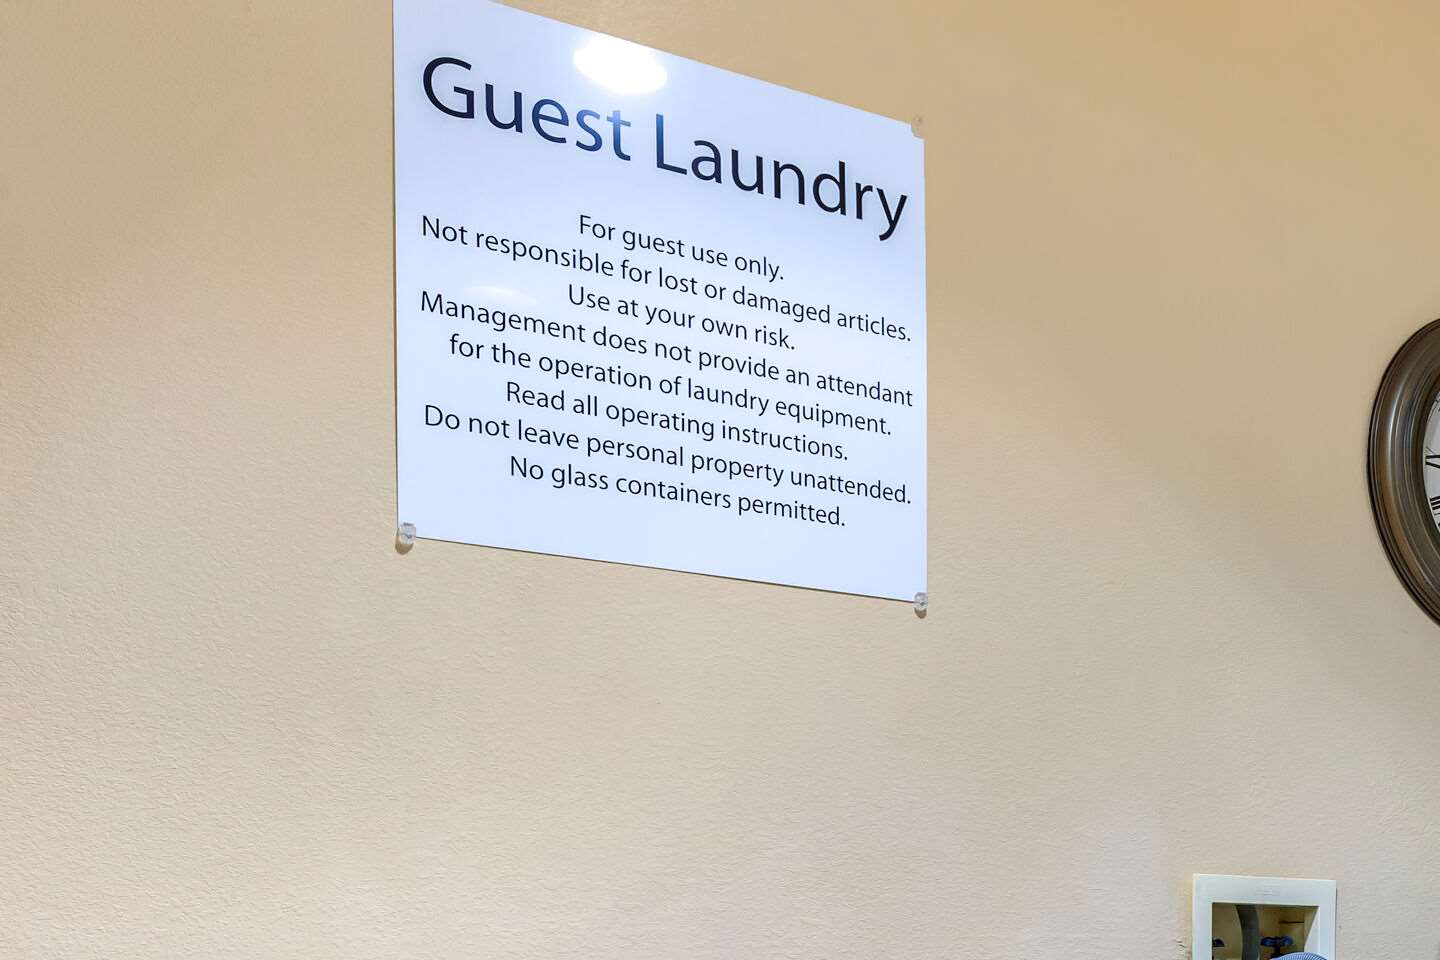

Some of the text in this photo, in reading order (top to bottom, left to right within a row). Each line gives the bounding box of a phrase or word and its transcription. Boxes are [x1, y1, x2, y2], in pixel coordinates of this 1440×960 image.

[422, 56, 908, 242] Guest Laundry
[422, 214, 911, 342] Not responsible for lost or damaged articles.
[579, 214, 784, 284] For guest use only.
[420, 289, 913, 408] Management does not provide an attendant
[568, 283, 795, 351] Use at your own risk.
[449, 332, 892, 436] for the operation of laundry equipment.
[506, 381, 848, 461] Read all operating instructions.
[424, 404, 912, 505] Do not leave personal property unattended.
[510, 455, 846, 527] No glass containers permitted.
